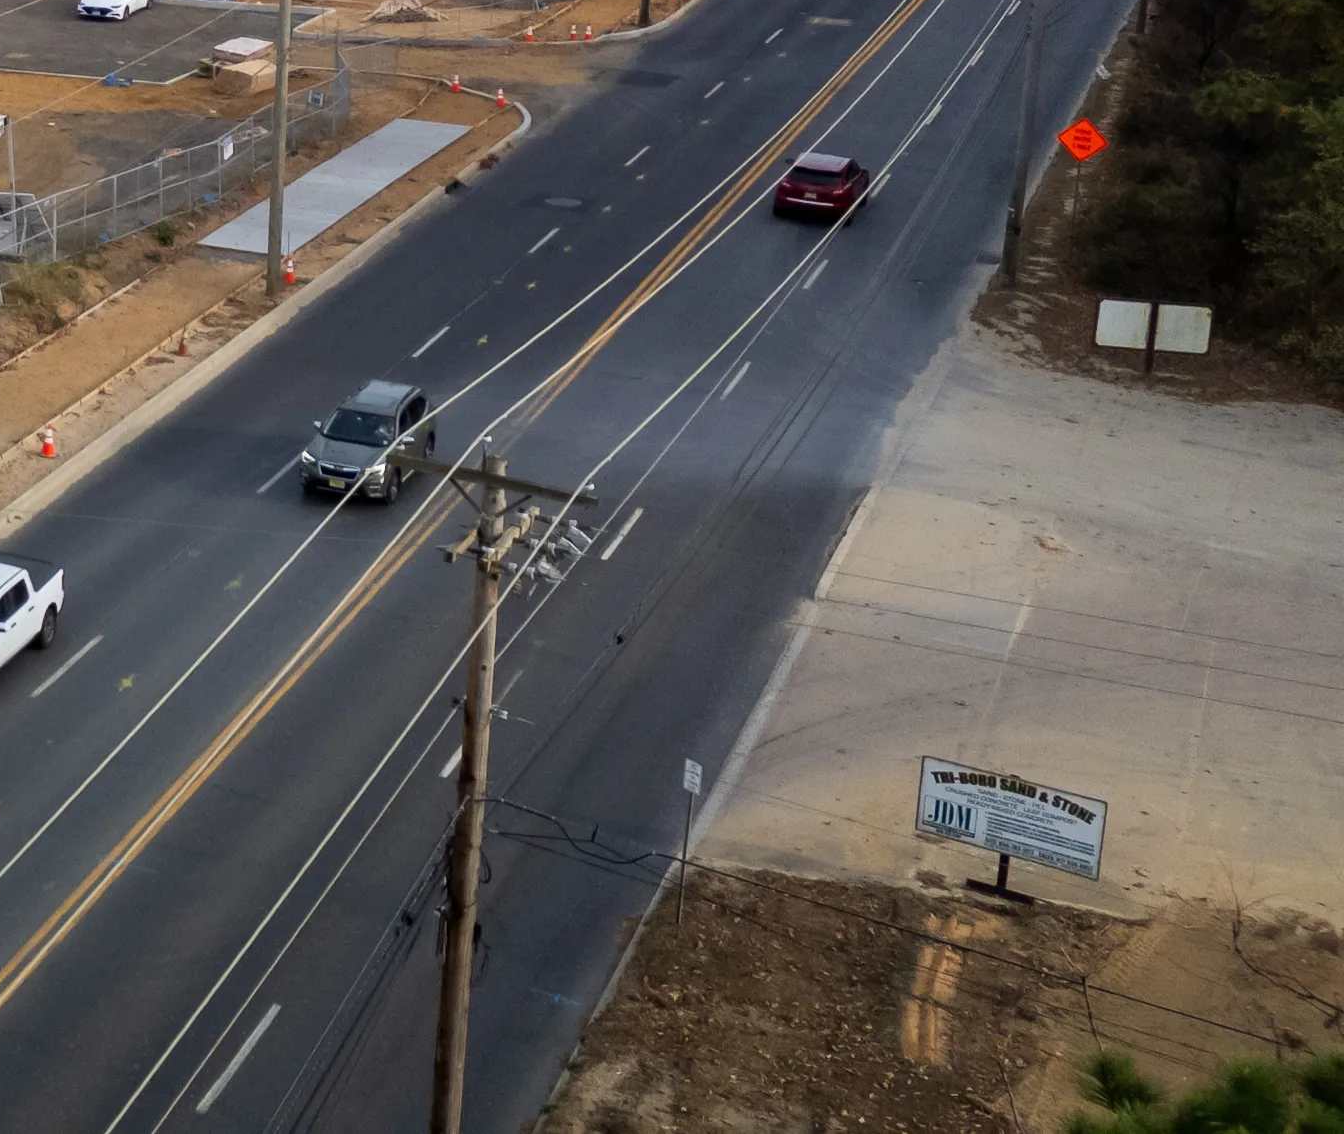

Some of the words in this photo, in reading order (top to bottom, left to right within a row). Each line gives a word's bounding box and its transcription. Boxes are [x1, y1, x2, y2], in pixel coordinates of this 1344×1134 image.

[927, 800, 971, 831] JDM
[930, 771, 997, 788] TRI-BORO
[1000, 777, 1037, 798] SAND
[1038, 791, 1049, 804] &
[1052, 794, 1096, 825] STONE
